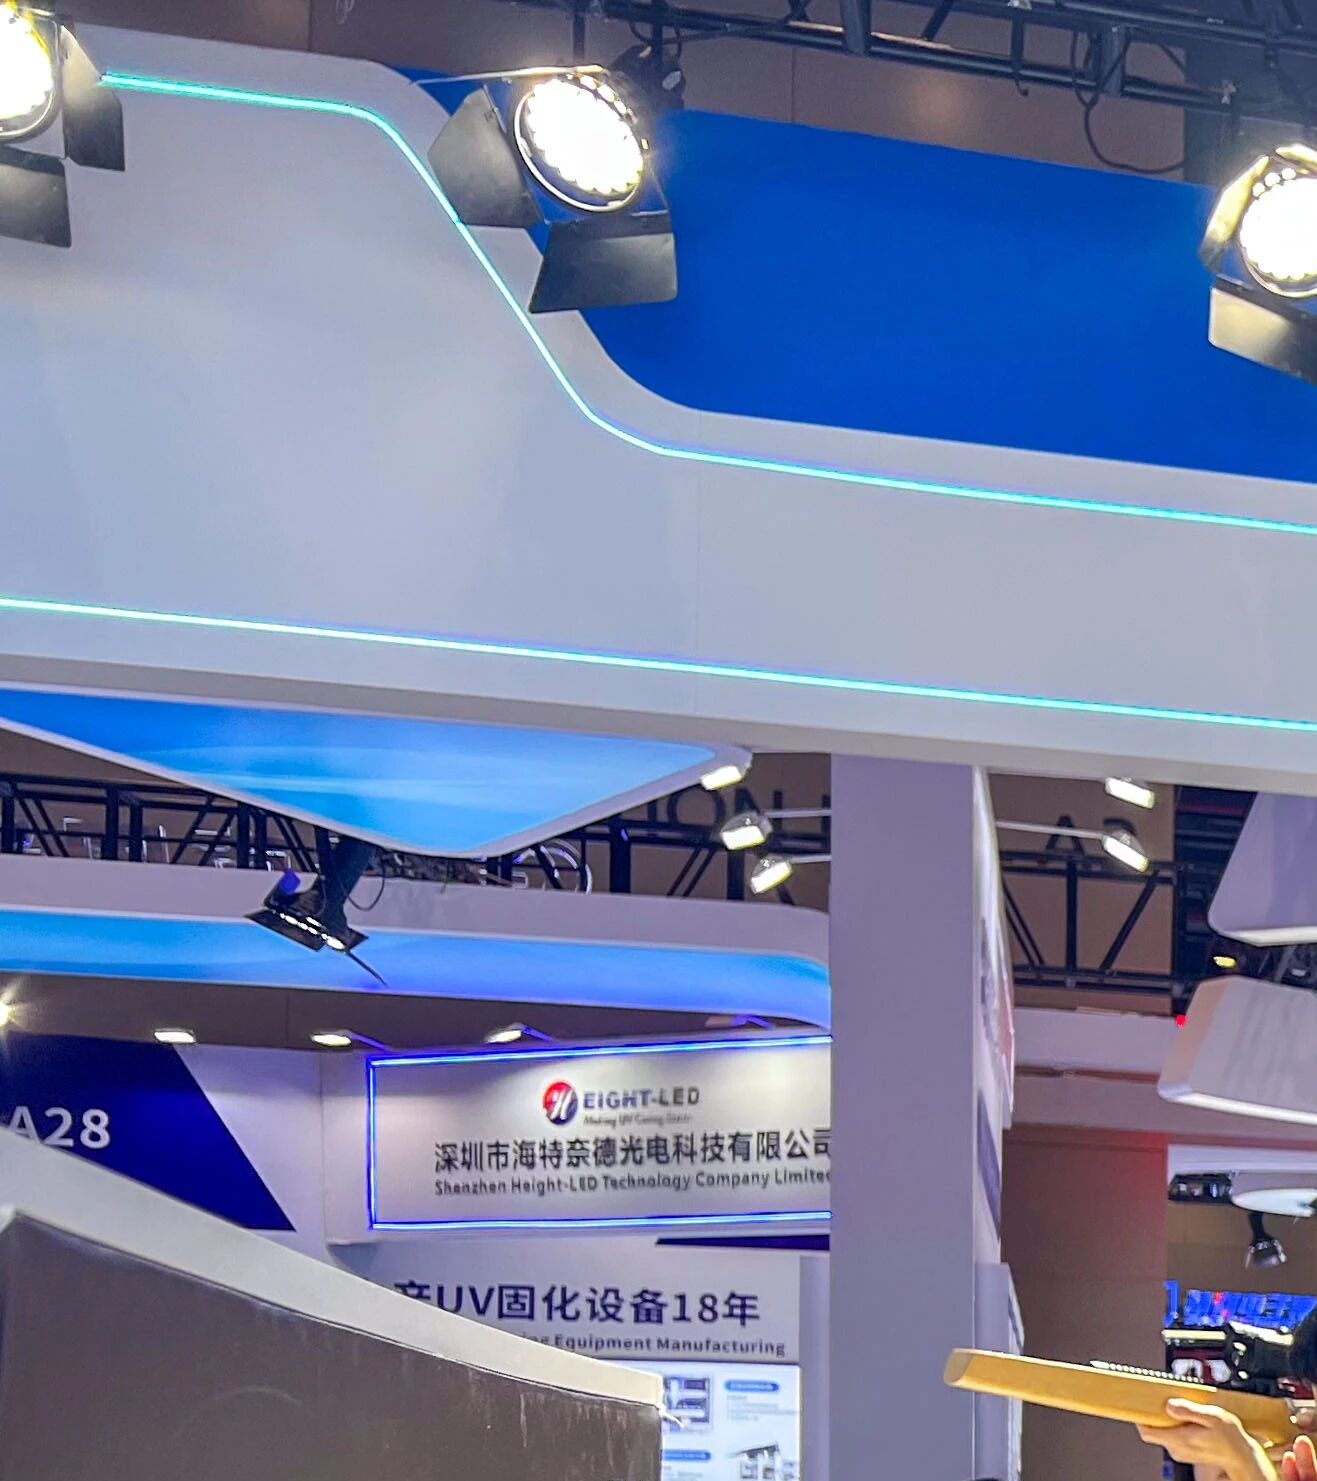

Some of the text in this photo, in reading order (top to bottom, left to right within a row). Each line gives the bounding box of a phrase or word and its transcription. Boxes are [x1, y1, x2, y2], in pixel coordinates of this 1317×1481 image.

[8, 1105, 111, 1150] A28
[434, 1127, 831, 1174] 深圳市海特奈德光电科技有限公司
[434, 1178, 507, 1196] Shenzhen
[511, 1176, 598, 1197] Height-LED
[603, 1170, 691, 1191] Technology
[695, 1169, 770, 1189] Company
[553, 1333, 652, 1353] Equipment
[656, 1336, 786, 1357] Manufacturing
